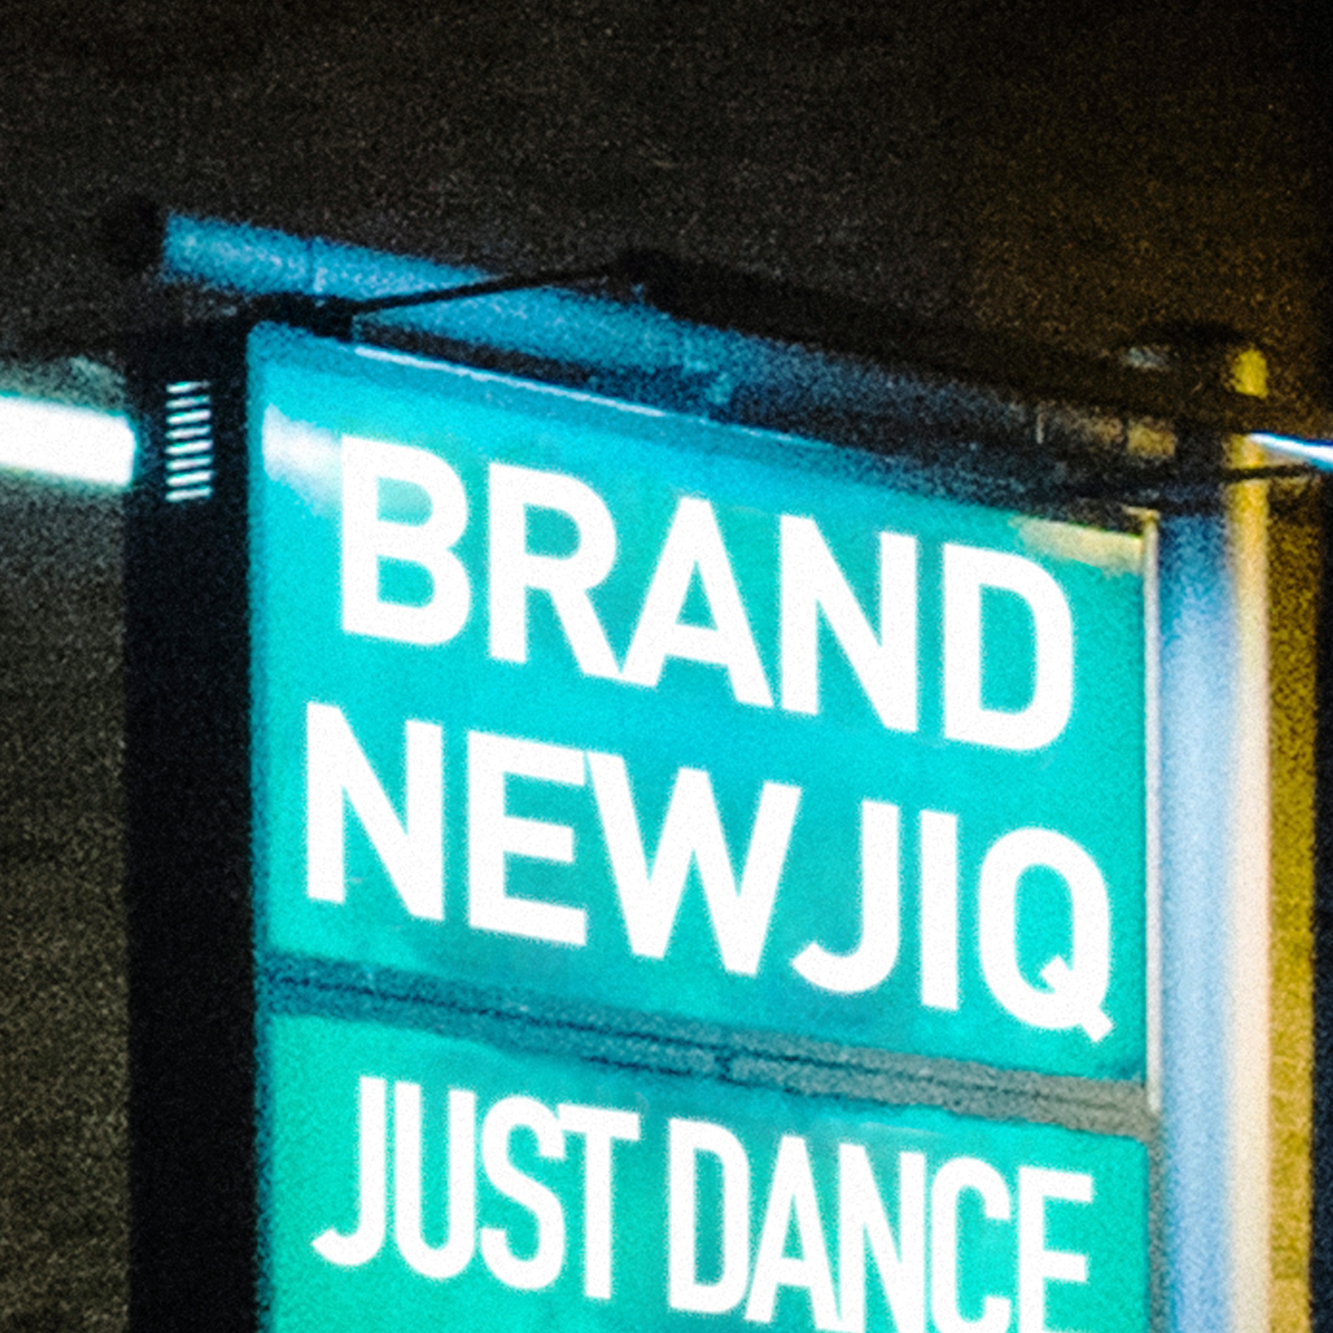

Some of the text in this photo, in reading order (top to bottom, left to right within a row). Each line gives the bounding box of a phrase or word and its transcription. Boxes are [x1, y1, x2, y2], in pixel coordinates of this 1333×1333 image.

[340, 434, 1074, 752] BRAND
[305, 700, 1114, 1043] NEW JIQ
[311, 1076, 640, 1300] JUST
